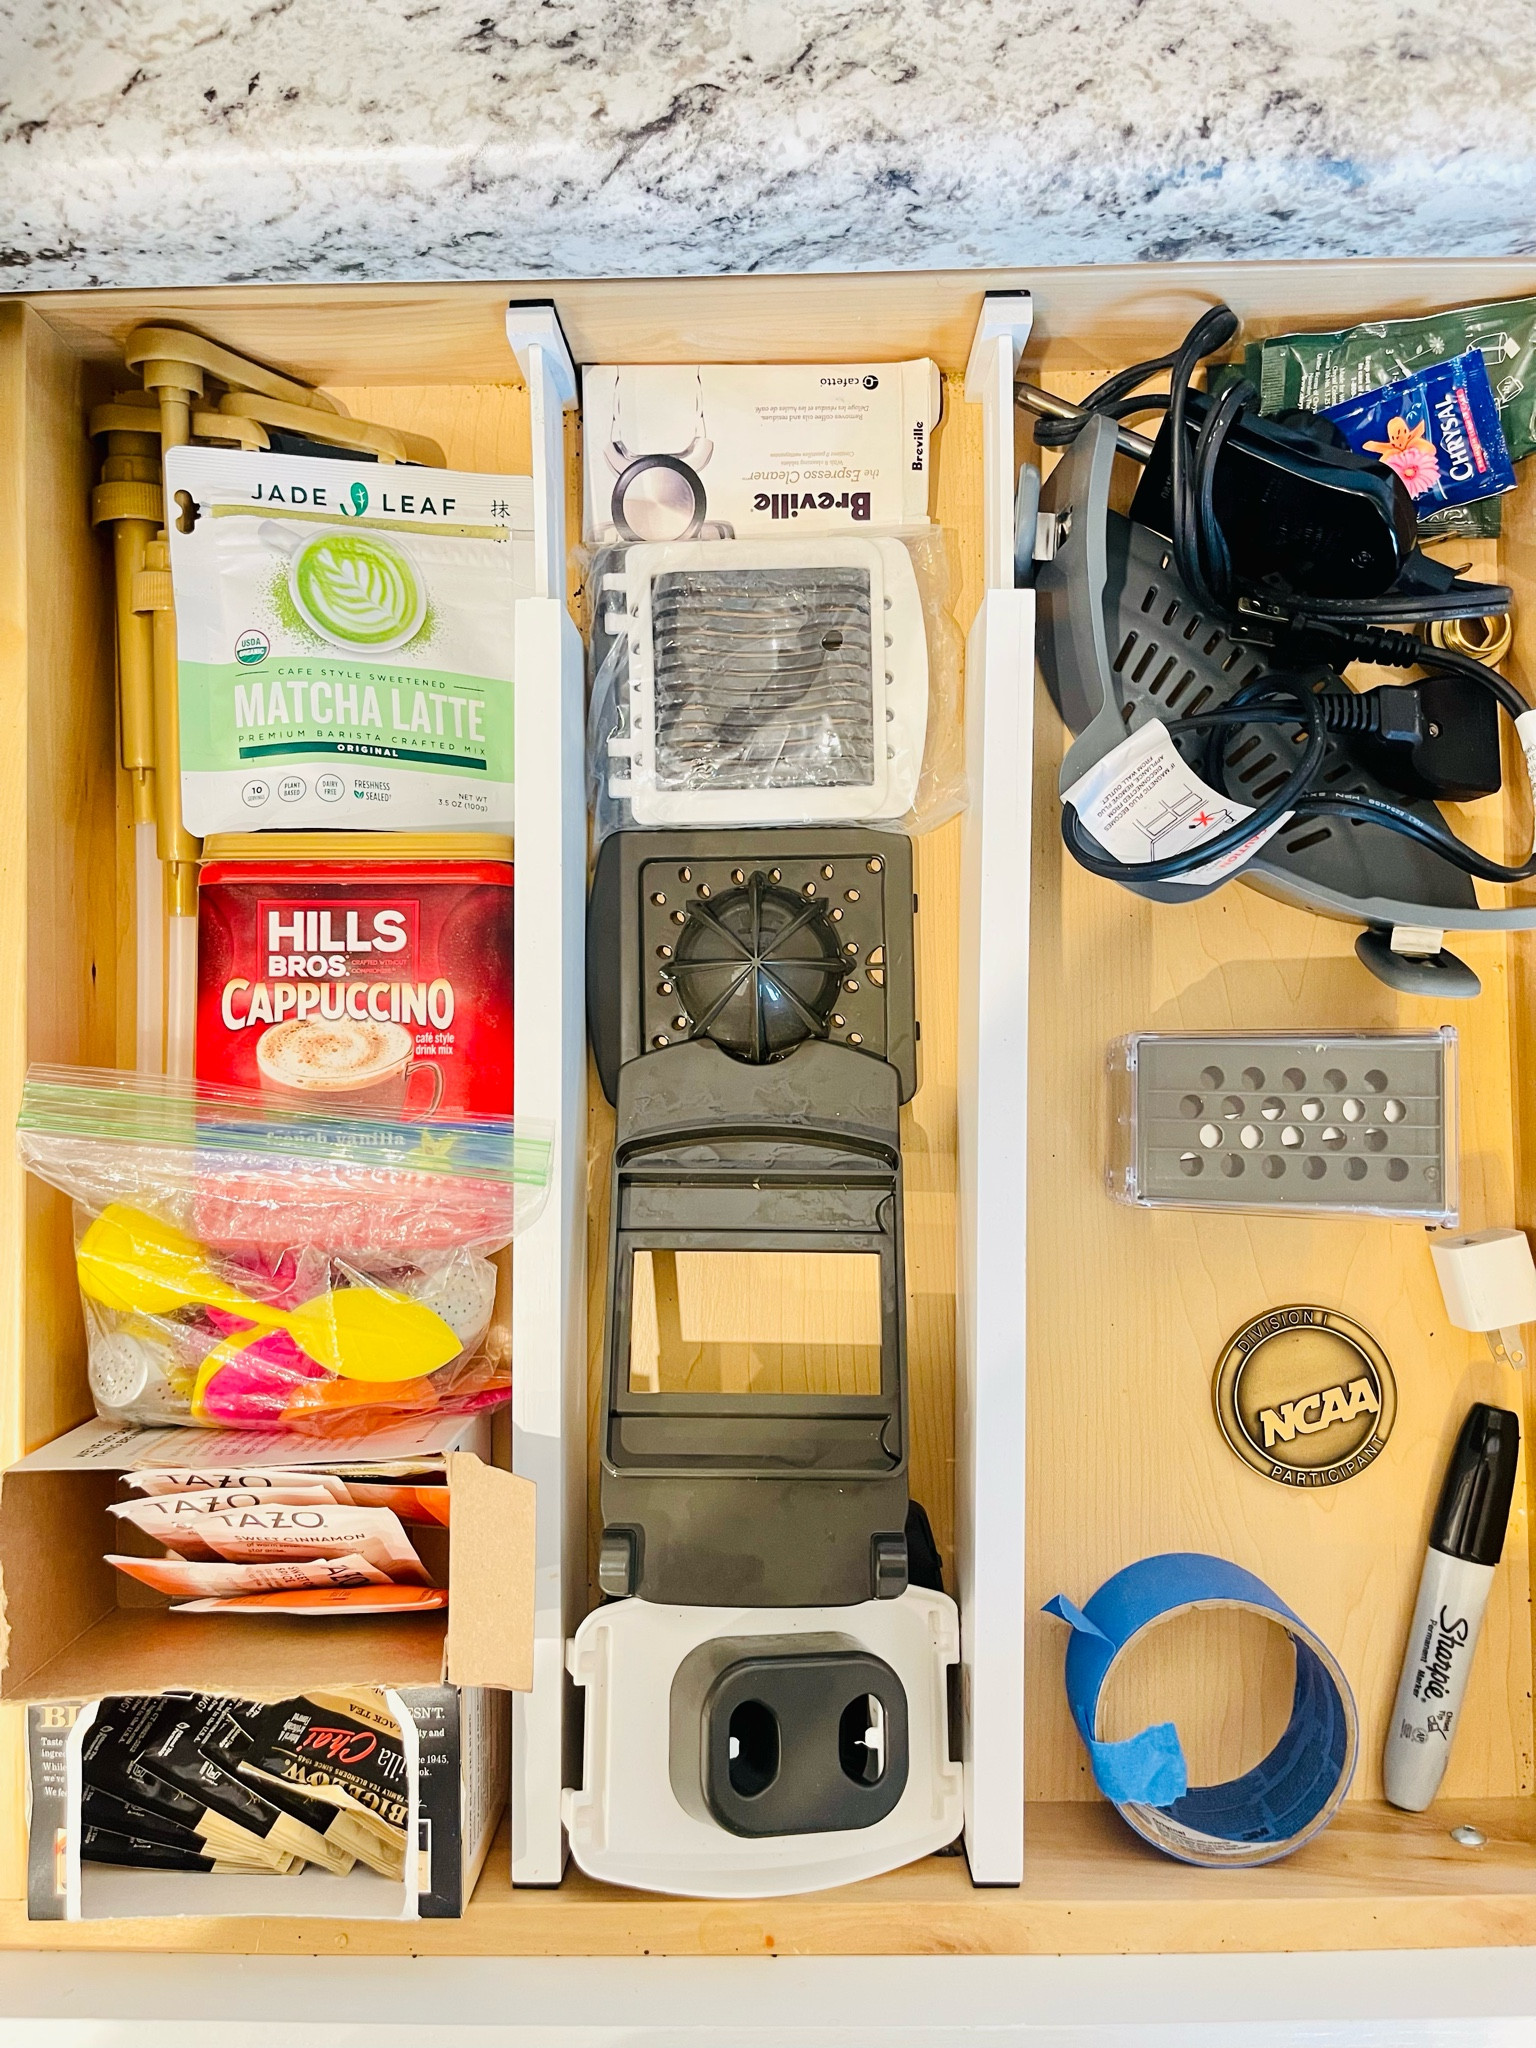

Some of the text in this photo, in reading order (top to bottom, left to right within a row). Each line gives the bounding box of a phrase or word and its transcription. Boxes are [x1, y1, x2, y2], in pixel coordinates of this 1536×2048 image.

[820, 377, 860, 387] cafetto
[912, 421, 924, 471] Breville
[1435, 394, 1474, 482] CHRYSAL
[803, 467, 861, 482] Espresso
[864, 469, 880, 480] the
[251, 483, 456, 516] JADE LEAF
[753, 492, 871, 521] Breville
[241, 638, 261, 647] USDA
[321, 669, 361, 679] STYLE
[369, 673, 446, 689] SWEETENED
[234, 681, 486, 742] MATCHA LATTE
[239, 729, 486, 755] PREMIUM BARISTA CRAFTED MIX
[337, 743, 399, 758] ORIGINAL
[324, 788, 337, 796] FREE
[354, 780, 391, 791] FRESHNESS
[1125, 765, 1163, 805] DISCONNECTED
[1144, 769, 1171, 795] MAGNETIC
[438, 798, 450, 806] 3.5
[464, 802, 488, 812] (100g)
[459, 793, 488, 803] NET WT
[1104, 807, 1130, 832] BECOMES
[268, 910, 408, 953] HILLS
[221, 977, 455, 1031] CAPPUCCINO
[415, 1032, 455, 1045] café style
[415, 1044, 453, 1055] drink mix
[1237, 1310, 1329, 1353] DIVISION I
[1260, 1377, 1380, 1448] NCAA
[1271, 1434, 1385, 1486] PARTICIPANT
[156, 1474, 272, 1488] TAZO
[144, 1493, 260, 1514] TAZO
[211, 1512, 326, 1529] TAZO
[283, 1533, 366, 1543] CINNAMON
[1412, 1619, 1438, 1698] Permanent Marker
[1424, 1604, 1469, 1701] Sharpie
[349, 1703, 401, 1732] ACK TEA
[408, 1707, 445, 1719] ESN'T.
[41, 1737, 63, 1746] Taste
[429, 1728, 445, 1737] and
[296, 1726, 377, 1763] Chai
[377, 1747, 408, 1784] illa
[427, 1755, 449, 1765] 1945,
[44, 1774, 65, 1782] we've
[297, 1755, 405, 1802] FAMILY TEA BLENDERS SINCE 1945
[45, 1786, 57, 1796] We
